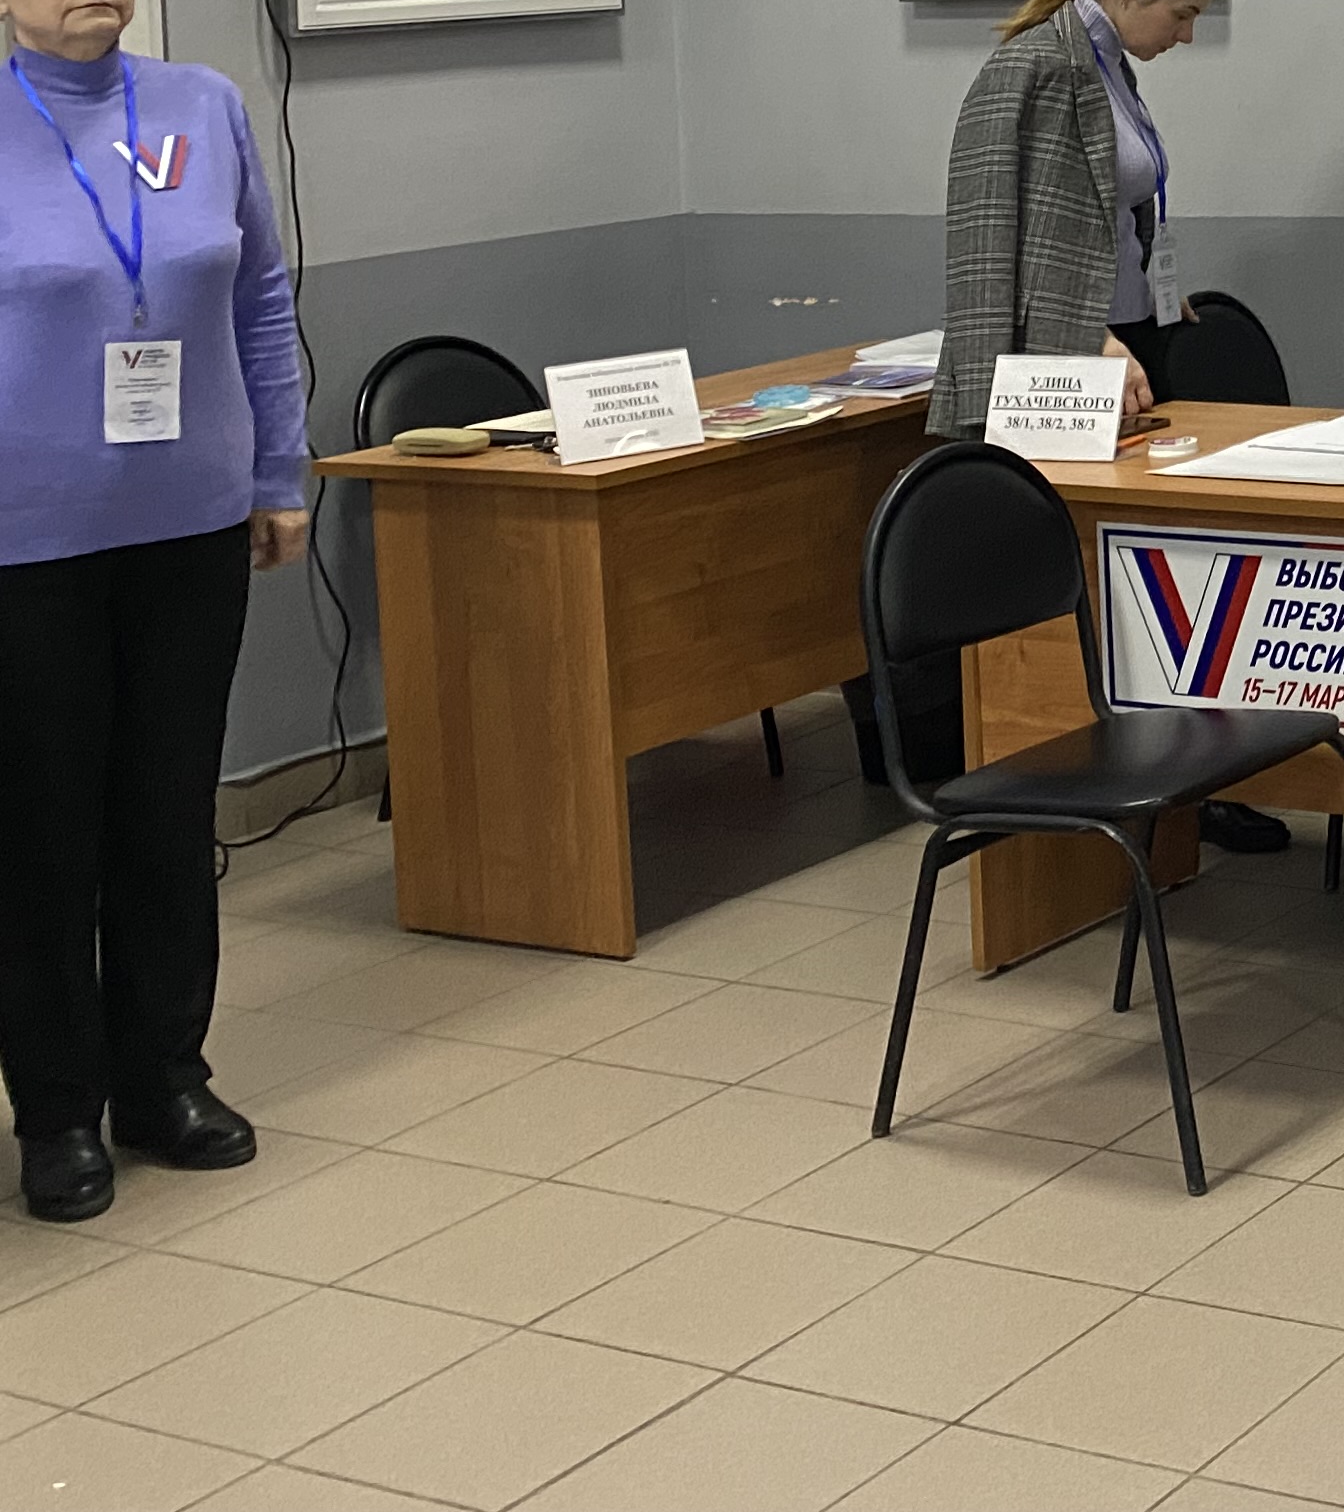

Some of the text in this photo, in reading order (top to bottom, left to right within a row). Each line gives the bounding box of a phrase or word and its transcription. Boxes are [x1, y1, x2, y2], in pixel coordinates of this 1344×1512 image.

[1030, 376, 1082, 391] УЛИЦА
[994, 395, 1114, 409] ТУХАЧЕВСКОГО
[1005, 417, 1095, 432] 38/1, 38/2, 38/3
